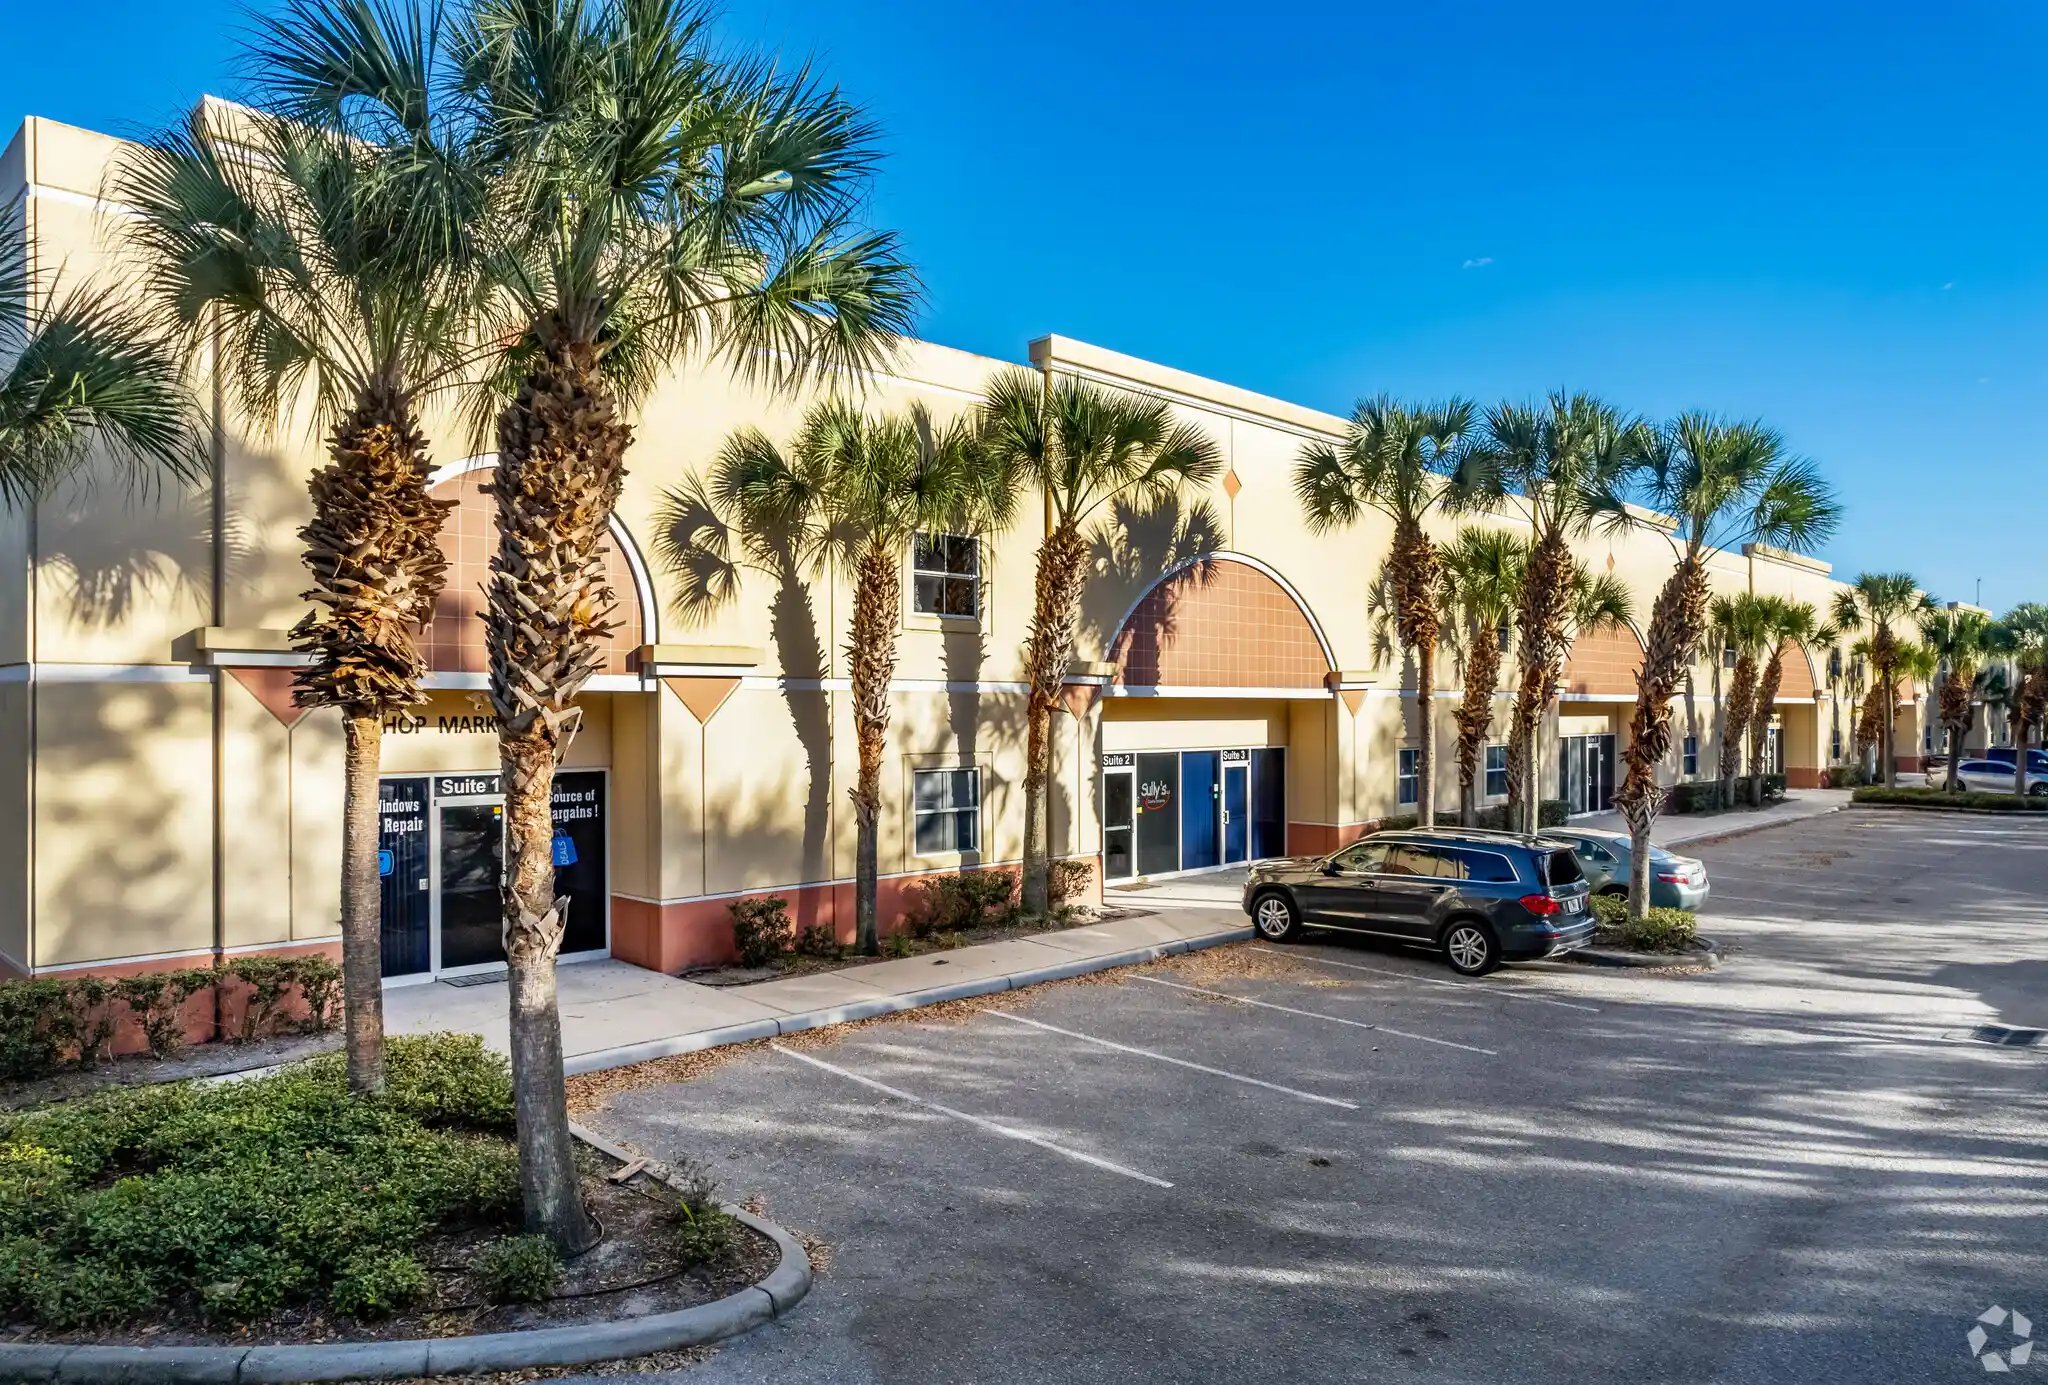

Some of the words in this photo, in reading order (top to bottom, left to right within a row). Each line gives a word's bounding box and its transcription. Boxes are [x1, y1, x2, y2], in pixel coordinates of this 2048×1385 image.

[1103, 755, 1124, 765] Suite
[1124, 754, 1130, 765] 2
[1223, 750, 1240, 760] Suite
[1240, 750, 1246, 760] 3
[441, 779, 487, 794] Suite
[491, 777, 500, 792] 1
[1141, 780, 1167, 800] Sully's
[585, 788, 595, 801] of
[383, 816, 424, 836] Repair
[558, 841, 570, 865] DEALS
